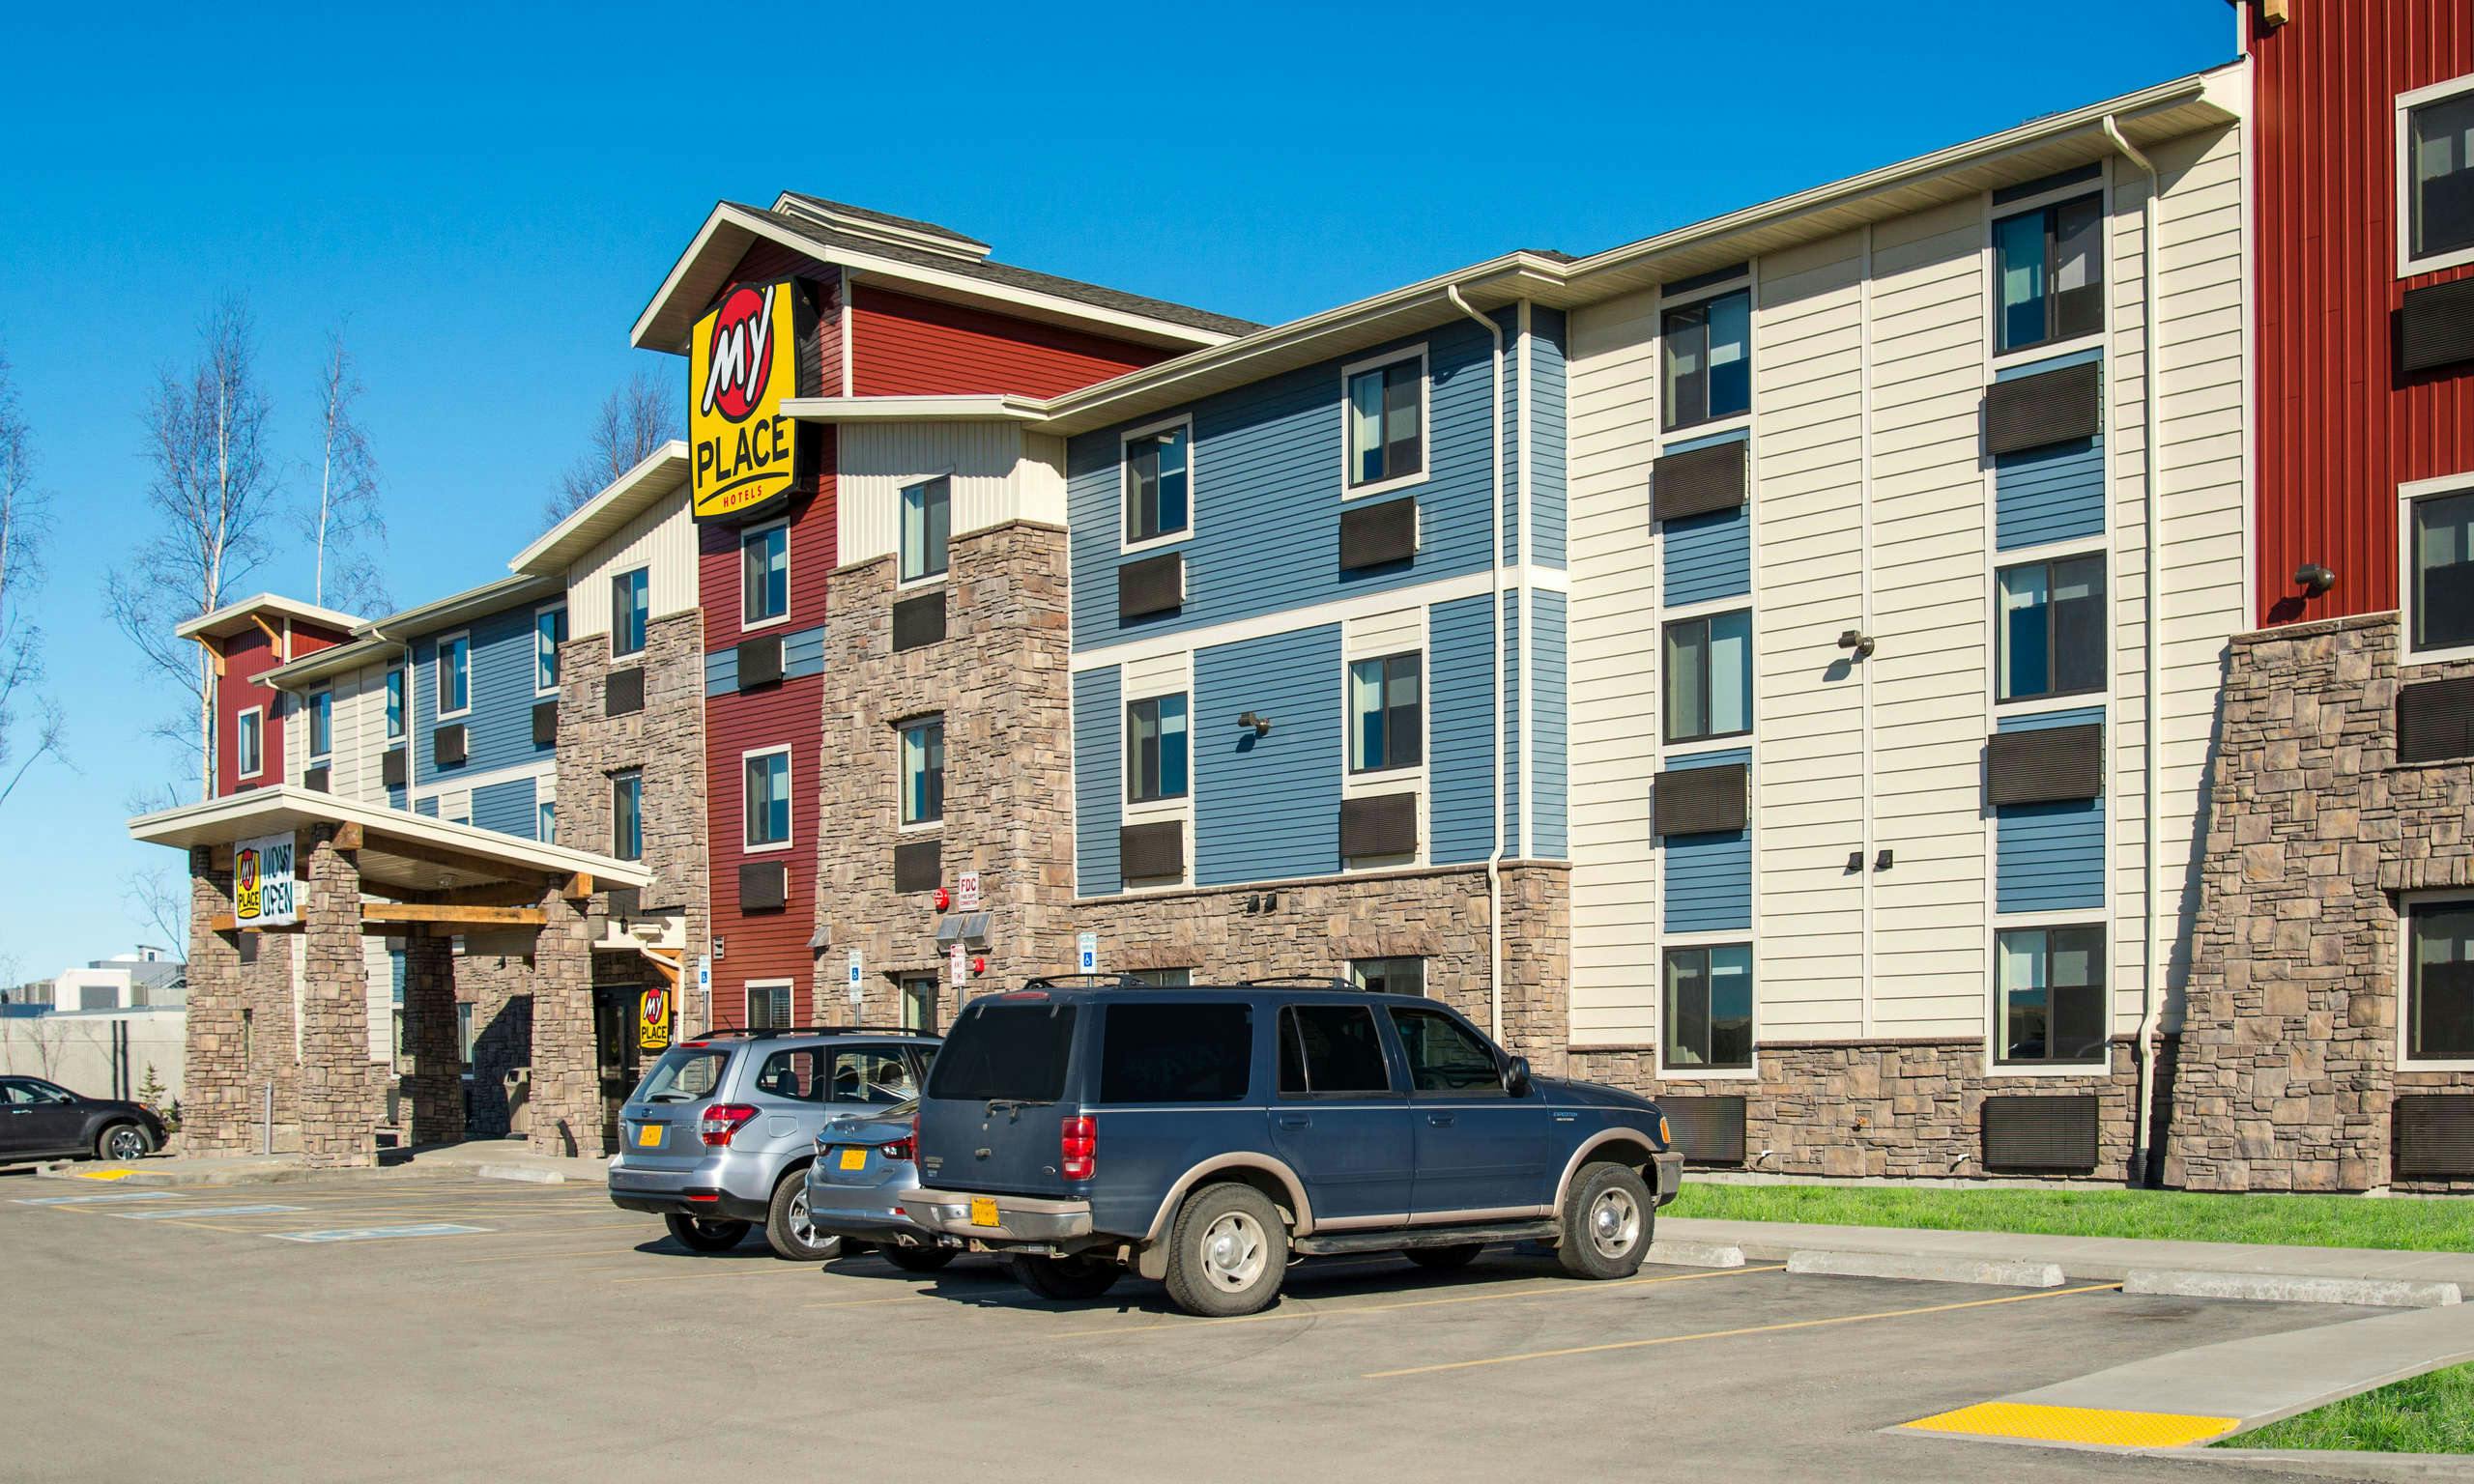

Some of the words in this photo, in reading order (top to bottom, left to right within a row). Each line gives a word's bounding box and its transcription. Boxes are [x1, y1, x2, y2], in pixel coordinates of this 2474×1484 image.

[698, 414, 790, 489] PLACE
[723, 485, 762, 508] HOTELS
[263, 843, 293, 880] NOW
[961, 877, 976, 893] FDC
[238, 891, 259, 908] PLACE
[262, 880, 293, 917] OPEN
[642, 1026, 667, 1039] PLACE
